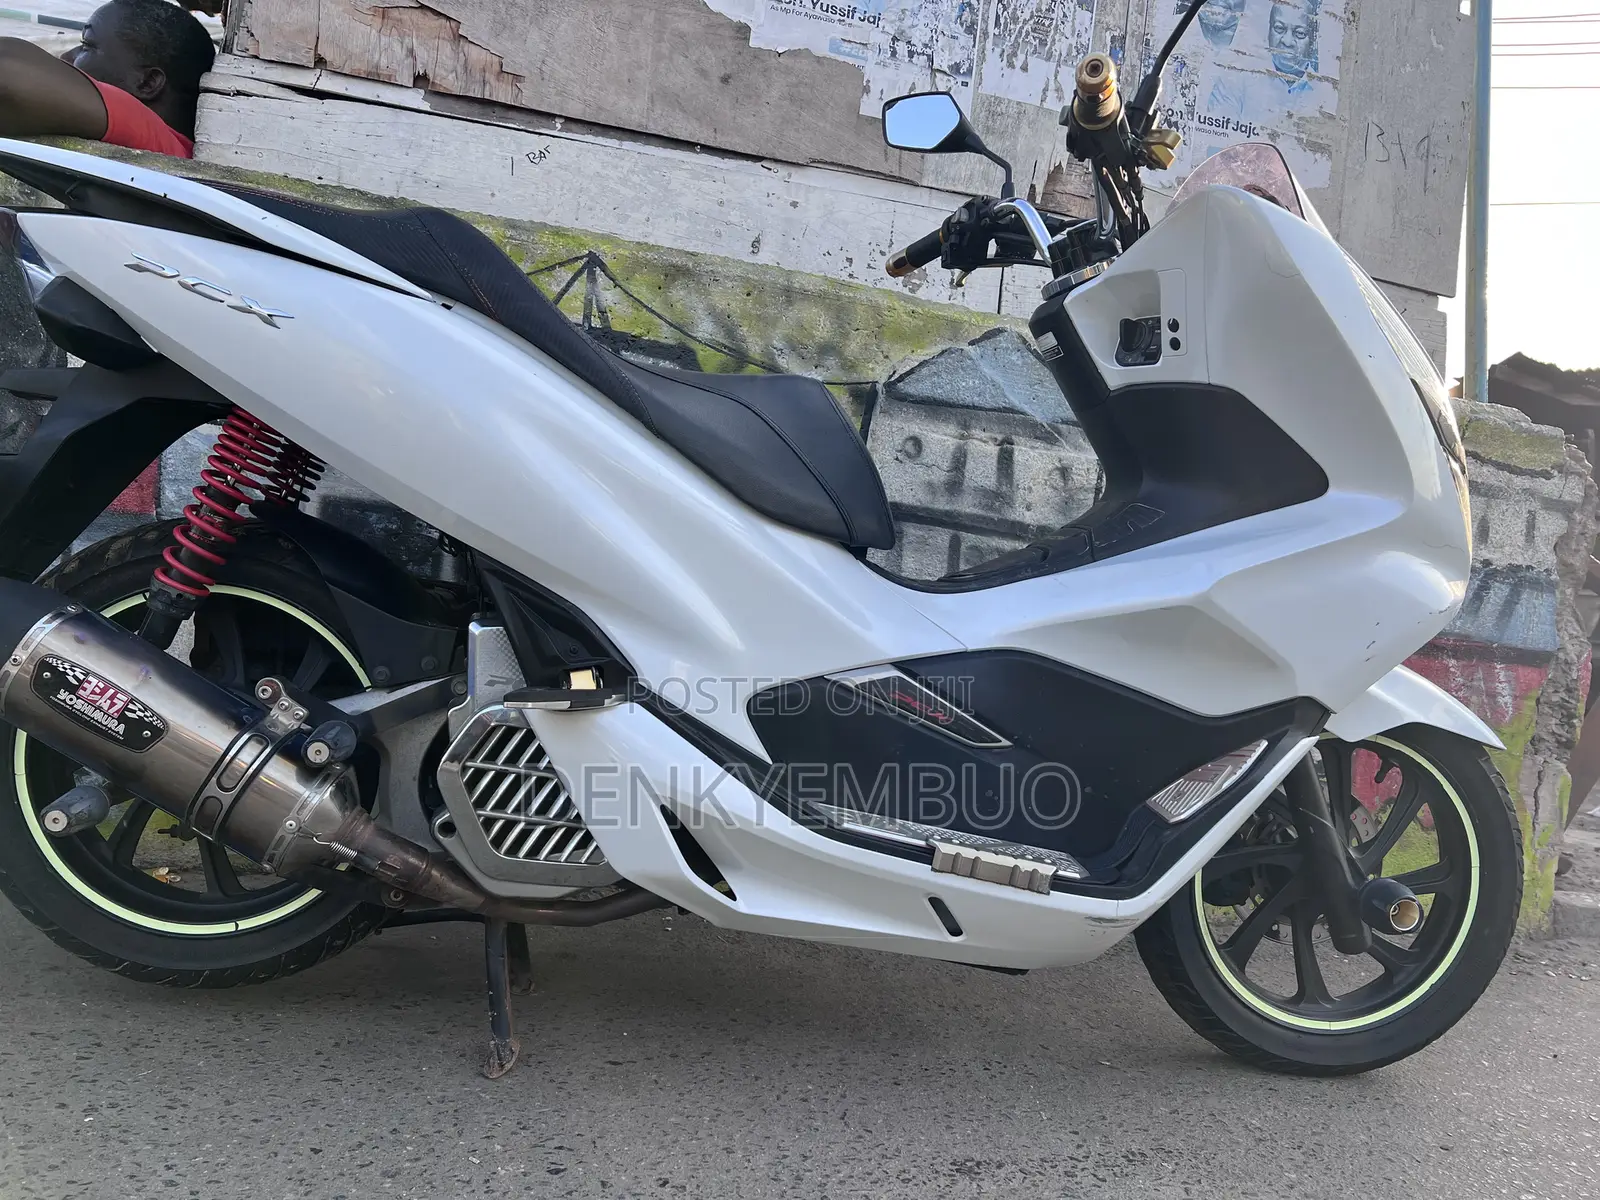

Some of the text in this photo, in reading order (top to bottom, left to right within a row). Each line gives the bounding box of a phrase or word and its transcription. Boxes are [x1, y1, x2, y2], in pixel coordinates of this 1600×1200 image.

[780, 6, 792, 15] Mp
[810, 0, 857, 19] Yussif
[858, 11, 881, 28] Jaj
[1212, 129, 1230, 138] North
[123, 252, 295, 329] PCX
[56, 688, 126, 735] YOSHIMURA
